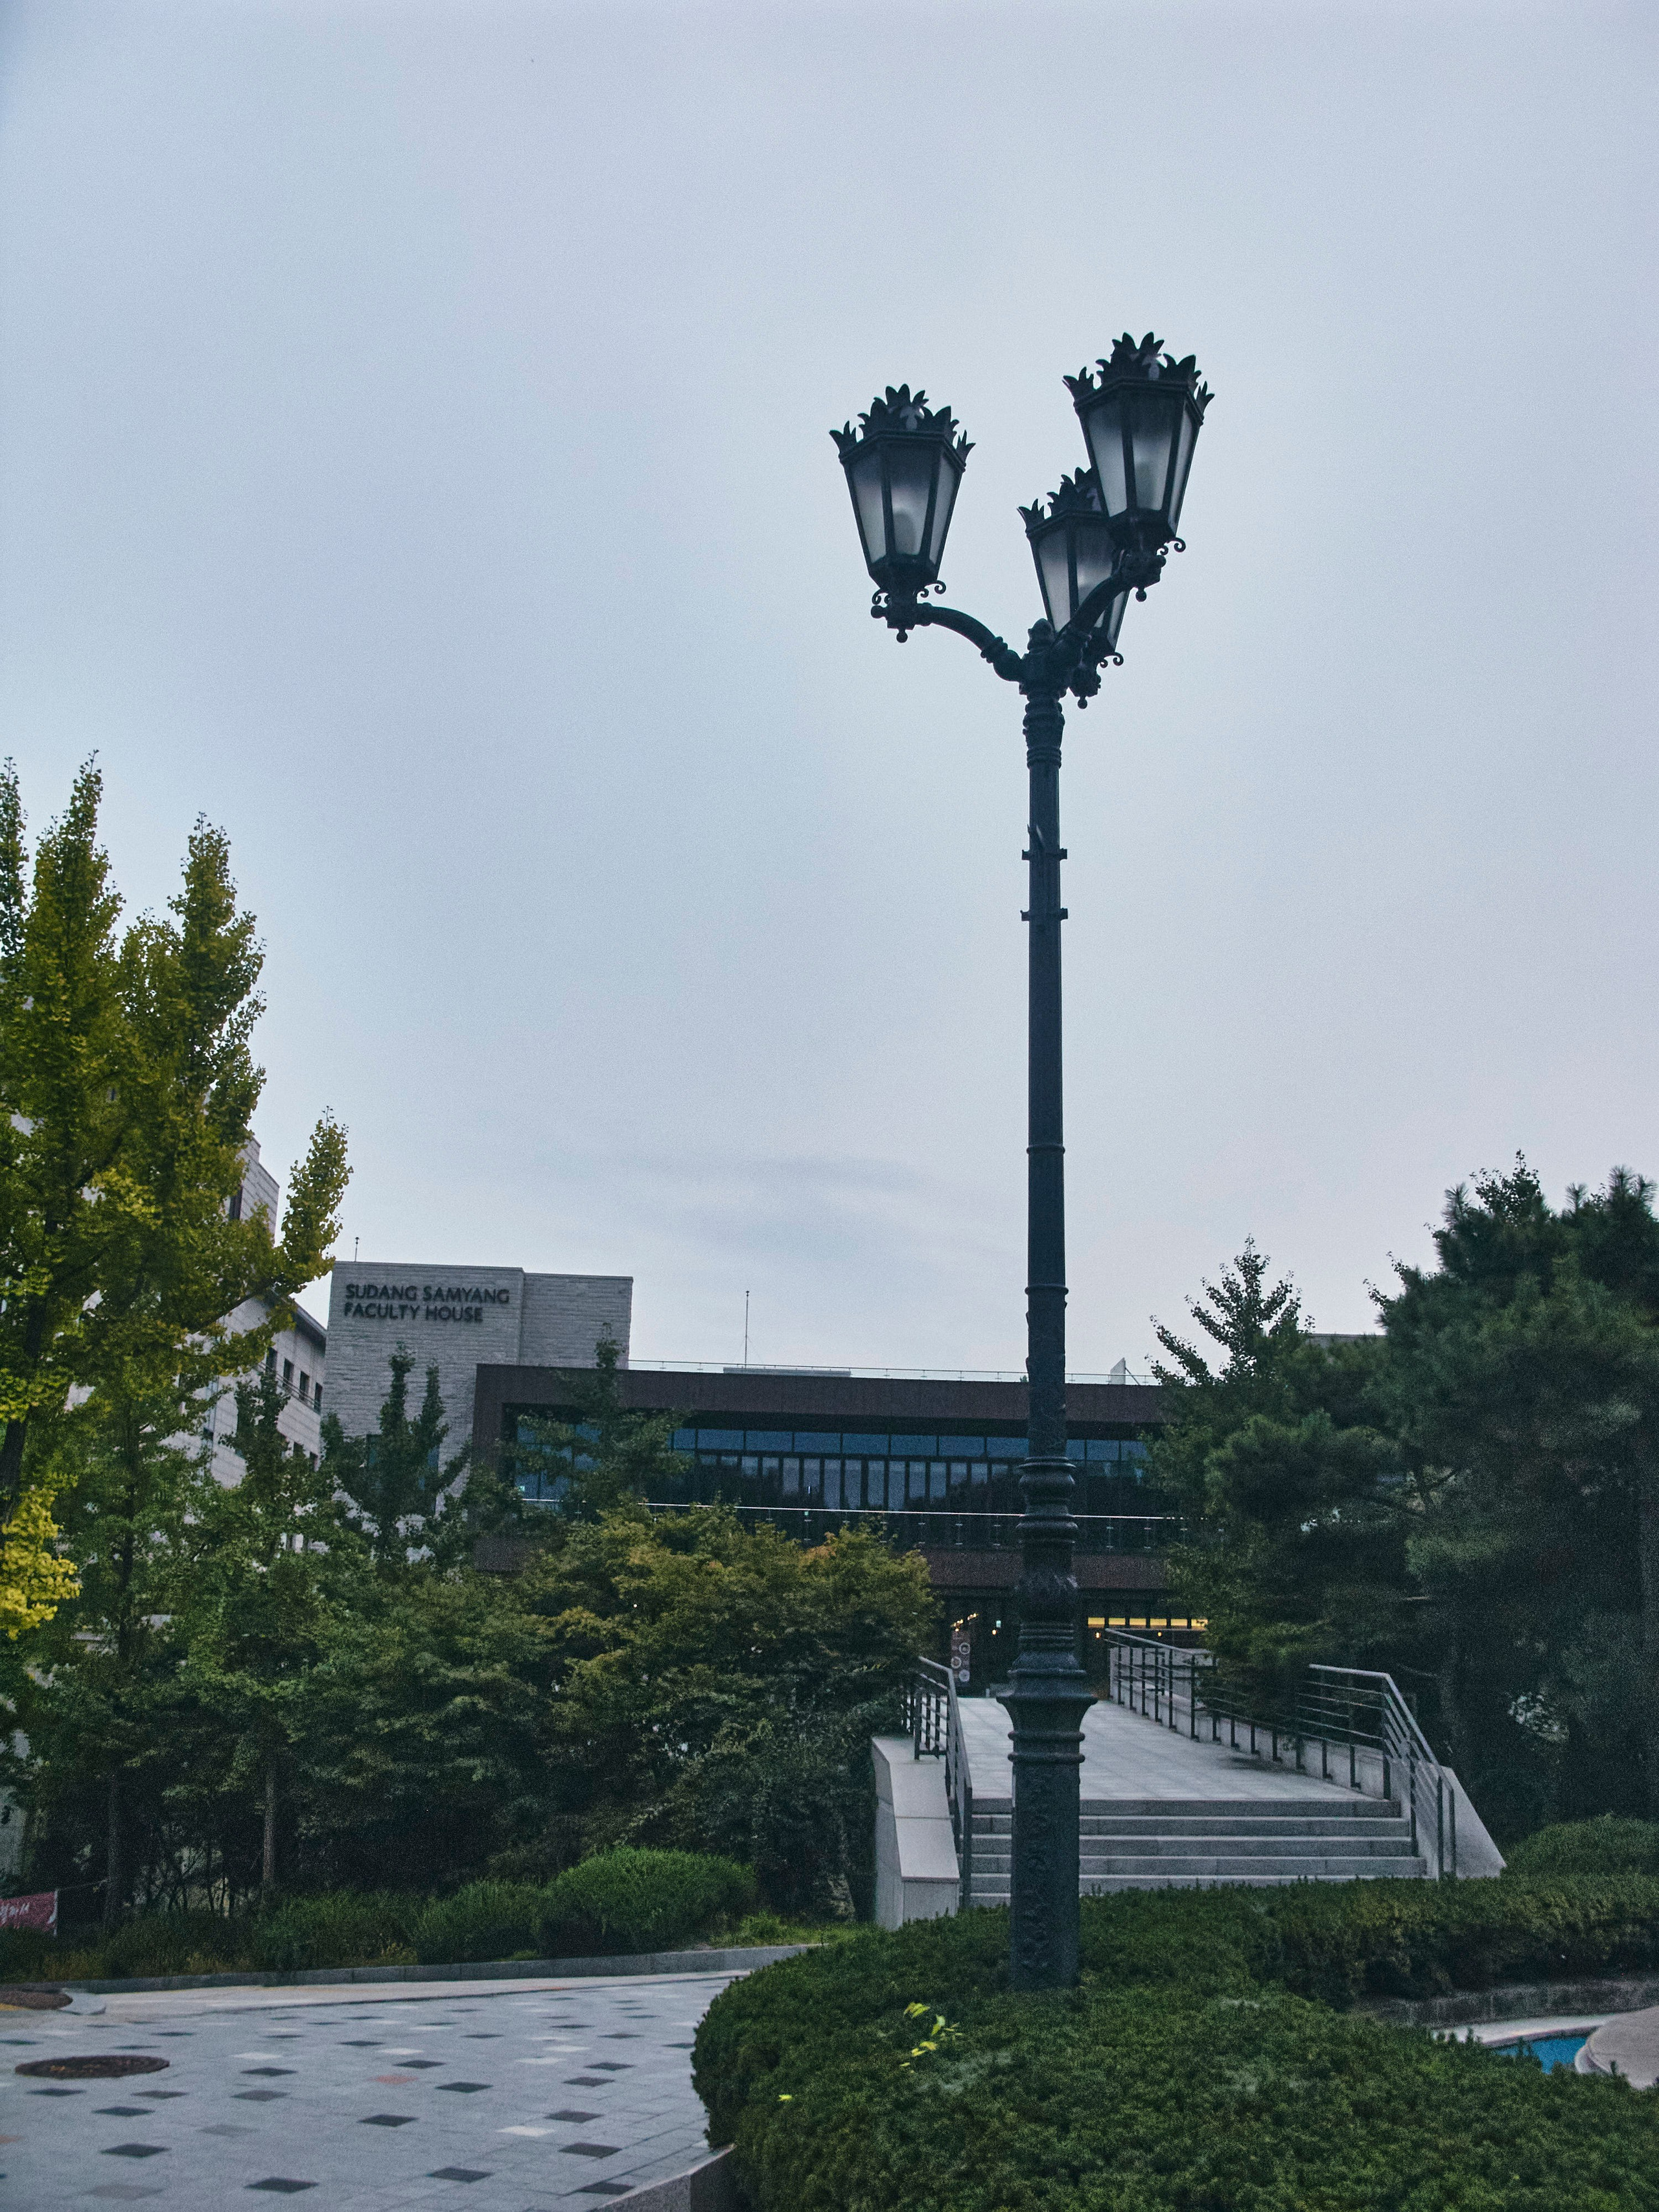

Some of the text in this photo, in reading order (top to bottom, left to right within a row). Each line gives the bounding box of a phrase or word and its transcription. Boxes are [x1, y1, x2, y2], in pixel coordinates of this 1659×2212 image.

[345, 1284, 510, 1304] SUDANG SAMYANG
[344, 1302, 483, 1322] FACULTY HOUSE
